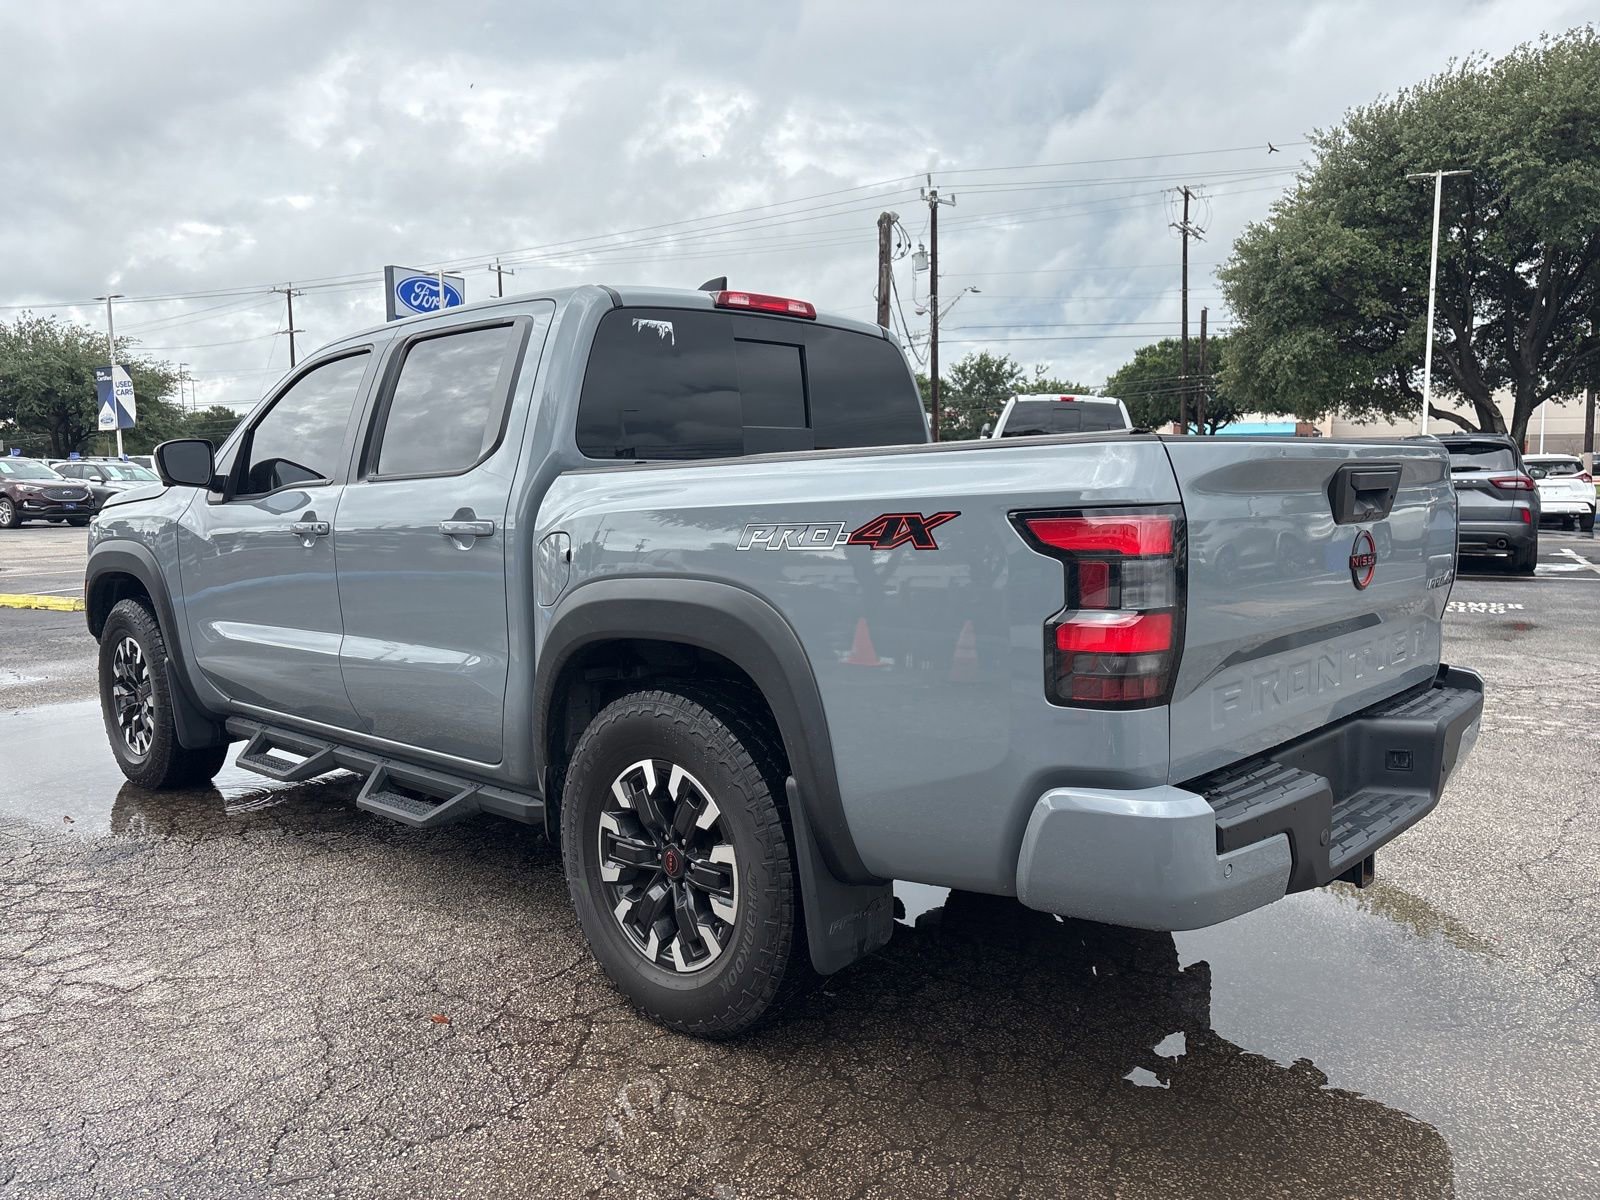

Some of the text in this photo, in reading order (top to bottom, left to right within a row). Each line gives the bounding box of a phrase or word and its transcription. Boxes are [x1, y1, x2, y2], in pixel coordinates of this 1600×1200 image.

[115, 380, 133, 388] USED
[115, 388, 134, 396] CARS
[1352, 554, 1375, 567] NISS
[1448, 601, 1525, 610] OMER
